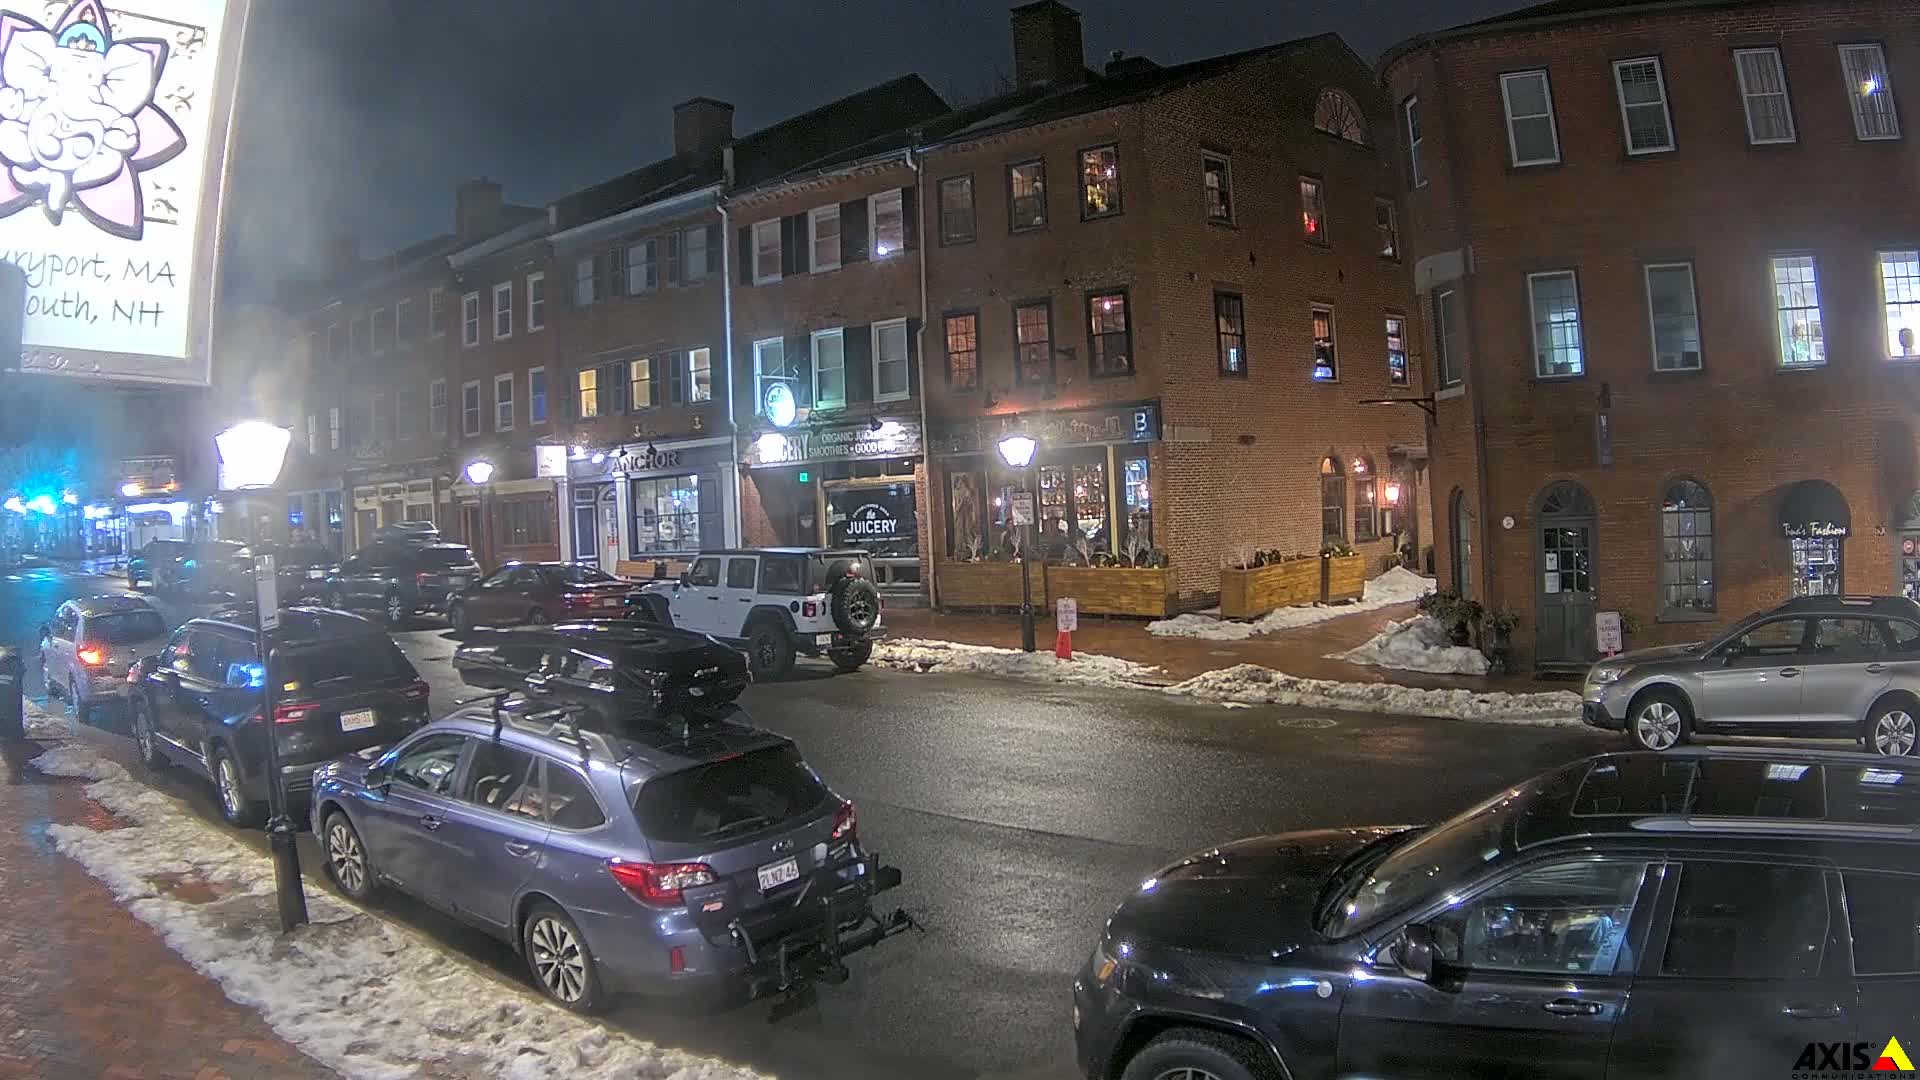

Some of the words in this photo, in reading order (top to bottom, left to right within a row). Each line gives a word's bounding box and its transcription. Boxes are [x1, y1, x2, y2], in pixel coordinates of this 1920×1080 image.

[123, 258, 176, 287] MA
[112, 299, 165, 328] NH
[1134, 412, 1147, 431] B
[612, 453, 678, 472] ANCHOR
[846, 519, 897, 535] JUICERY
